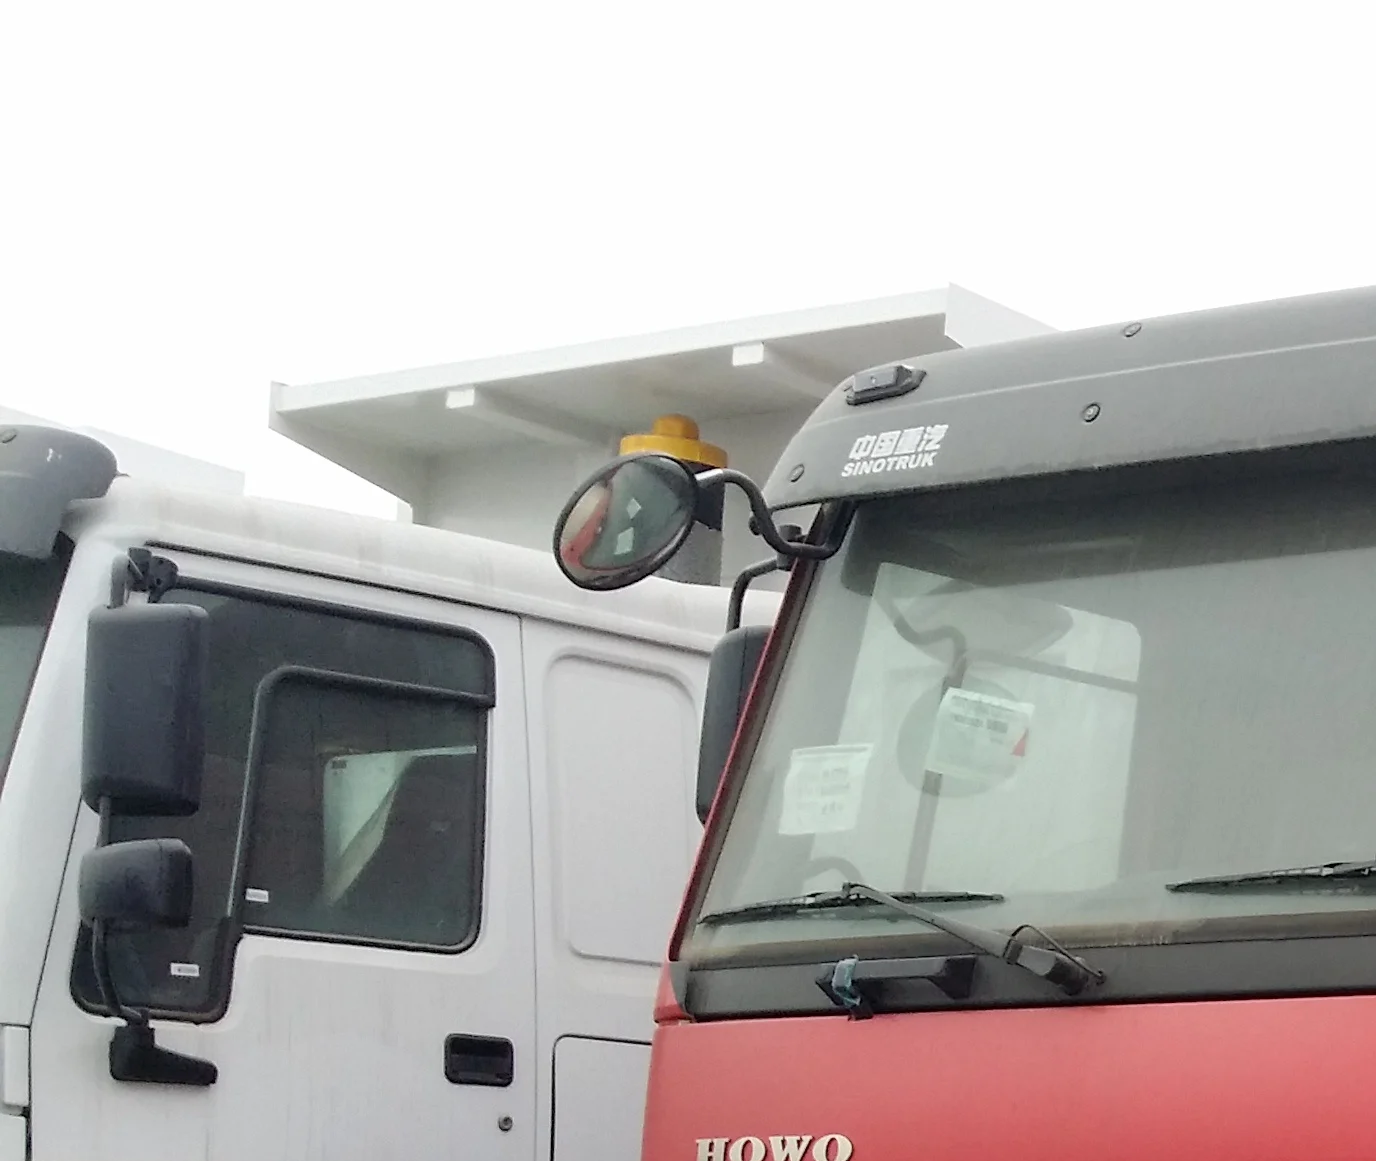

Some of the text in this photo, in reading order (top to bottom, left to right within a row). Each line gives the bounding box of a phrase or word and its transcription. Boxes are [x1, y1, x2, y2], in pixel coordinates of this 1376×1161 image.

[849, 424, 948, 460] 中国汽
[841, 452, 938, 477] SINOTRUK
